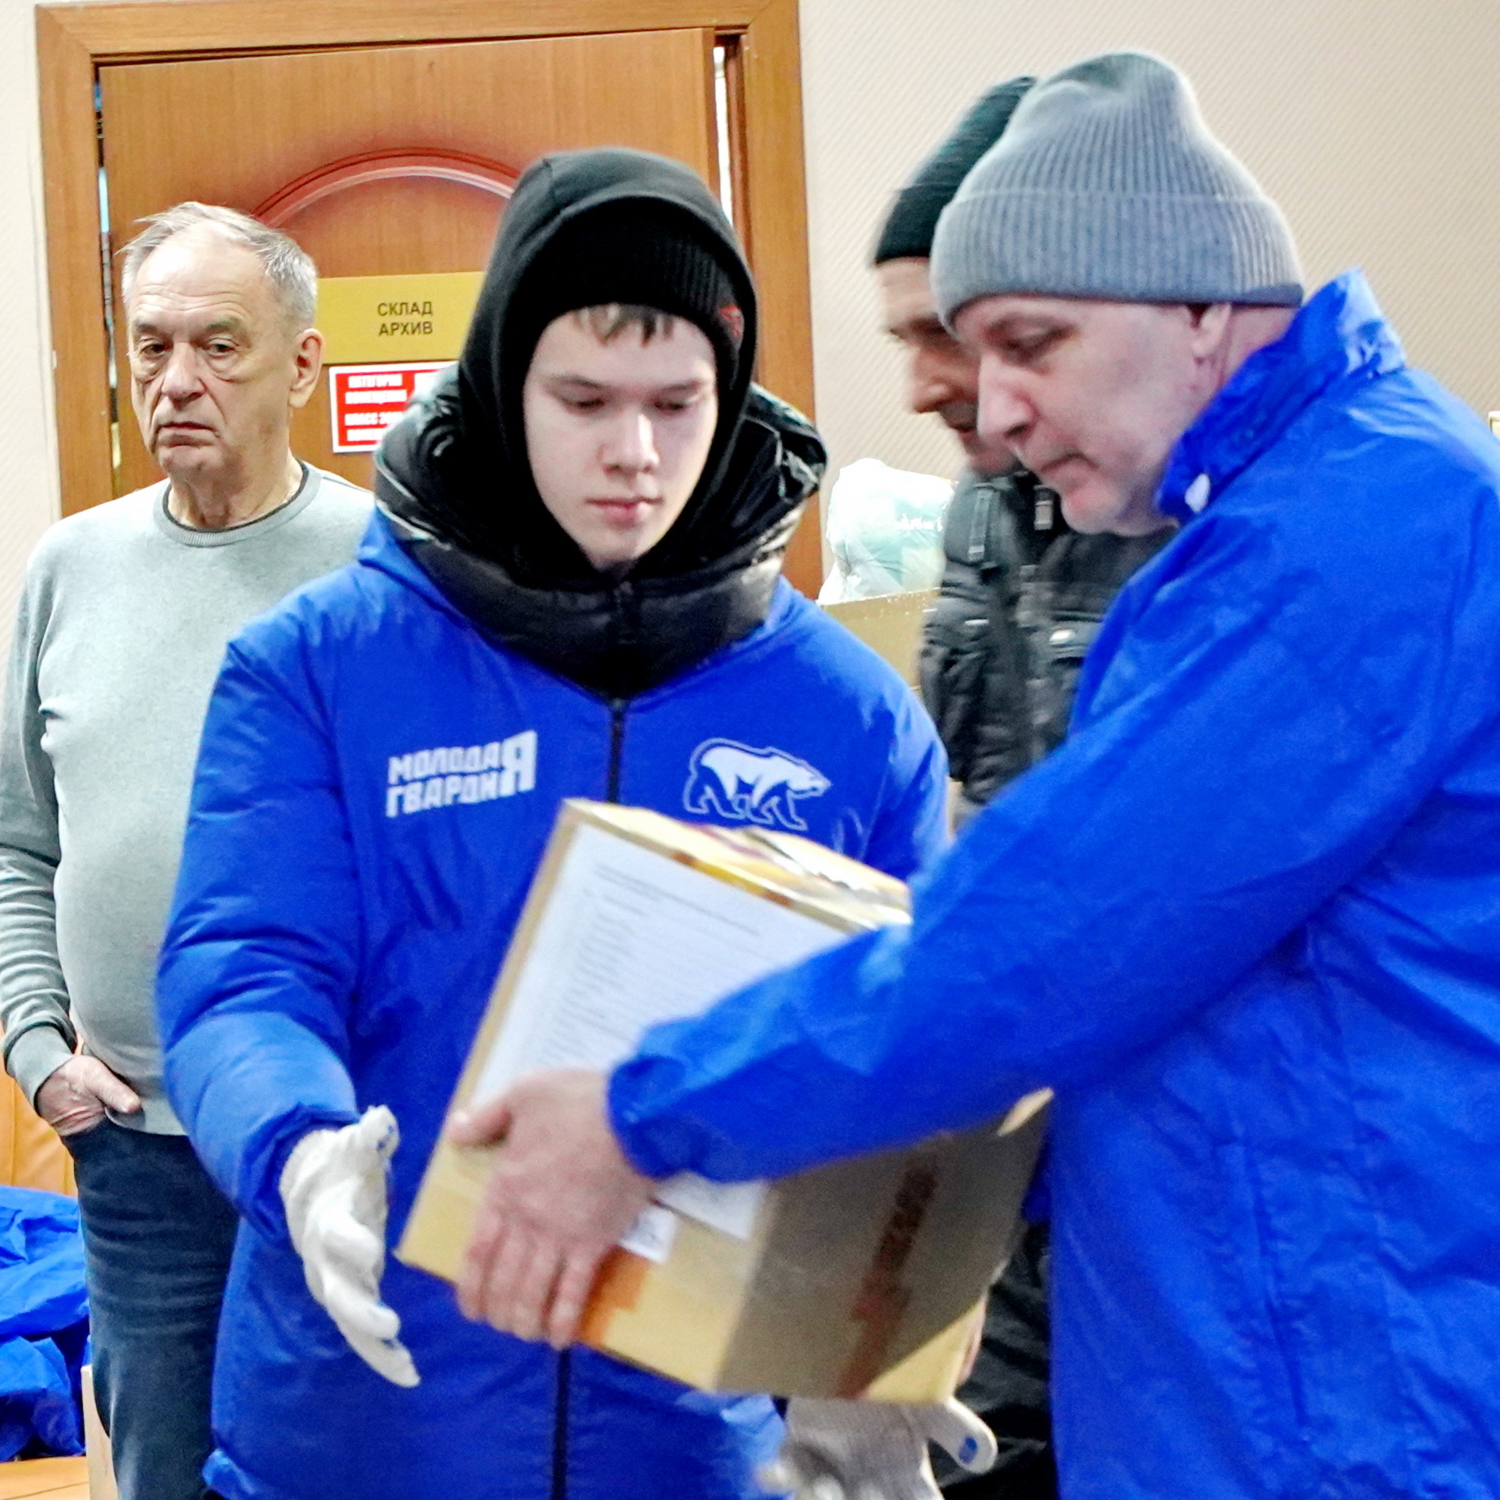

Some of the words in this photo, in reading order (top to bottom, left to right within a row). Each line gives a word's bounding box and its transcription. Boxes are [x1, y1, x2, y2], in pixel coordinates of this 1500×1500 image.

[376, 301, 434, 317] СКЛАД
[378, 320, 434, 337] АРХИВ
[388, 729, 538, 790] МОЛОДАЯ
